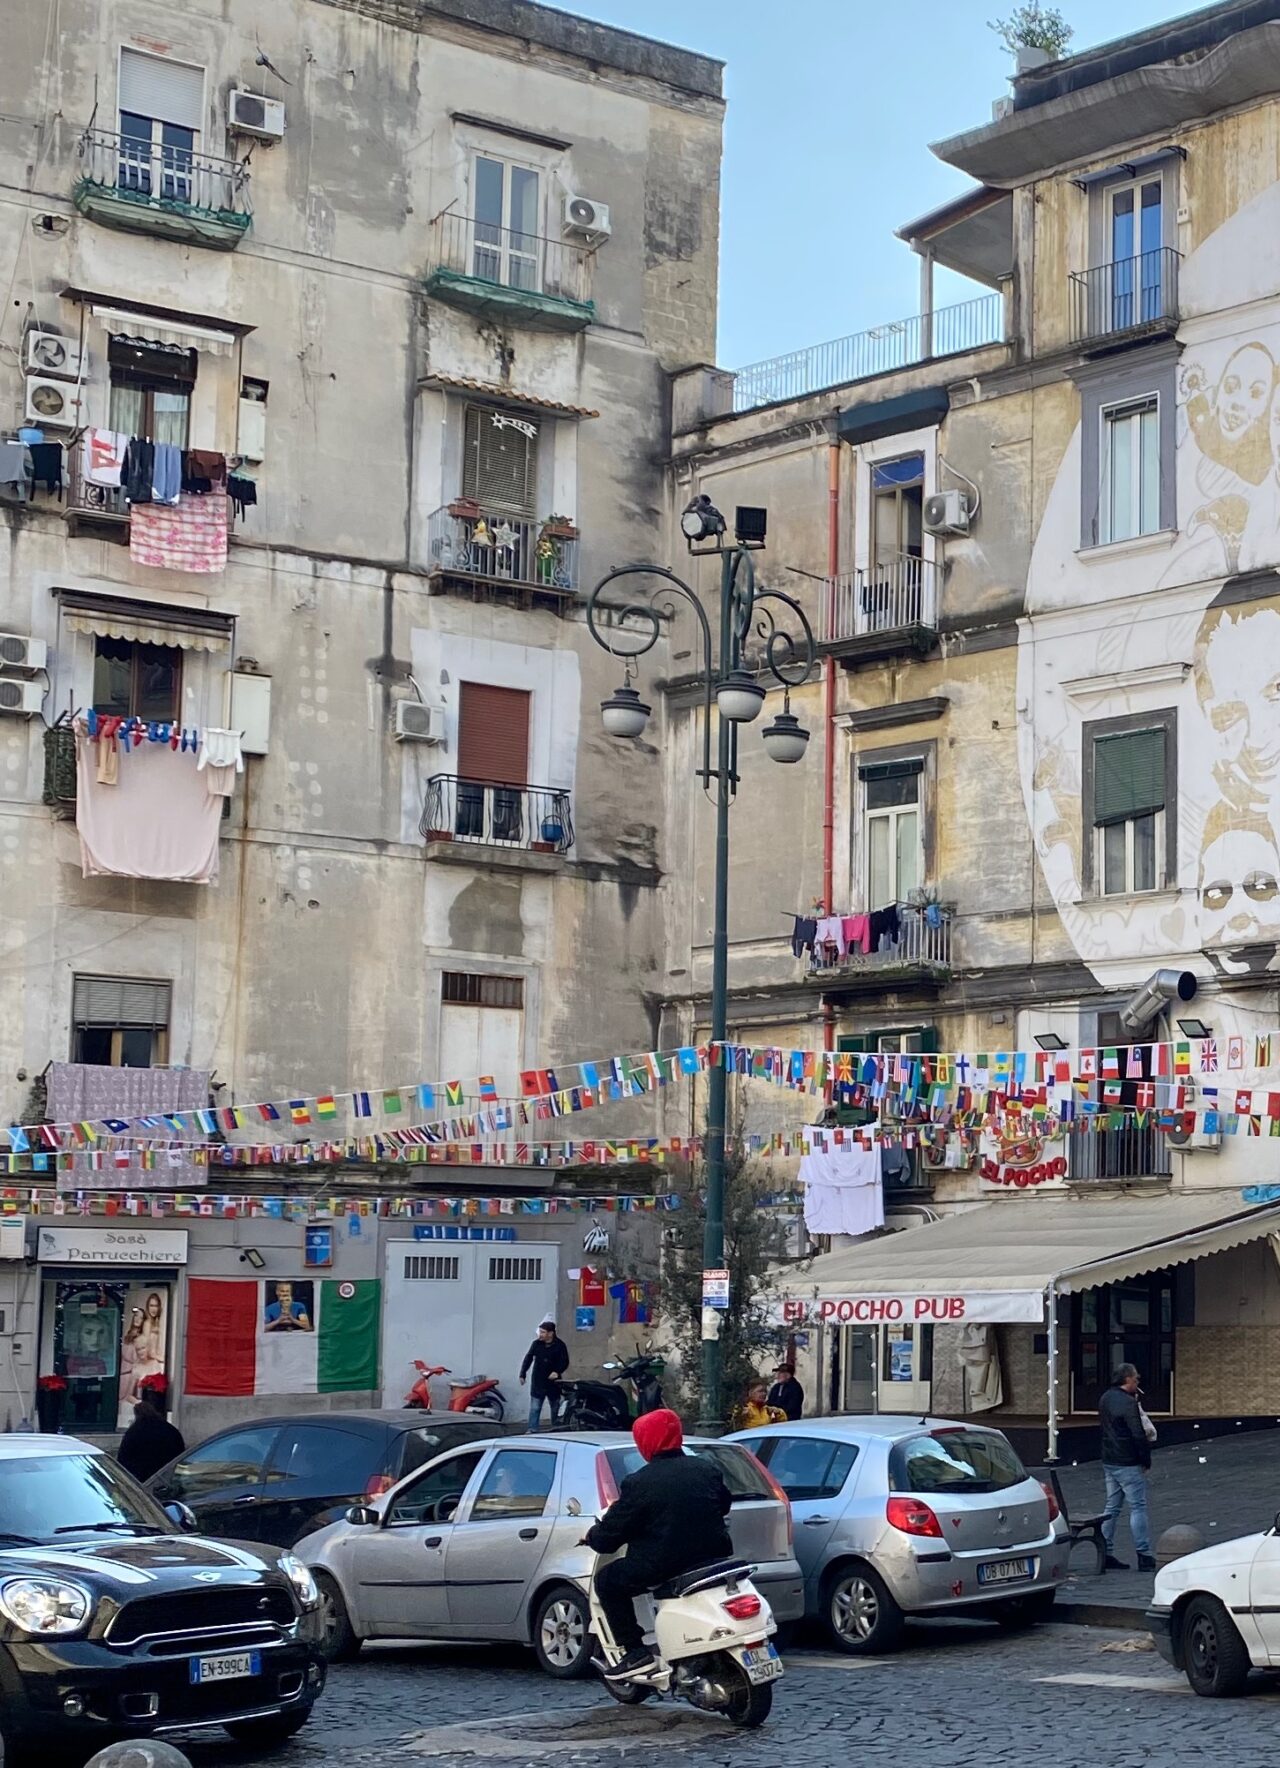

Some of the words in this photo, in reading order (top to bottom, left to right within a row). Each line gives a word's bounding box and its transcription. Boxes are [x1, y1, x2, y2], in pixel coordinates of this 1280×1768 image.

[979, 1159, 1002, 1183] EL
[1003, 1156, 1067, 1188] POCHO
[103, 1231, 147, 1245] Sasà
[67, 1247, 182, 1261] Parrucchiere
[820, 1300, 903, 1321] POCHO
[914, 1298, 965, 1320] PUB
[201, 1662, 215, 1677] EN
